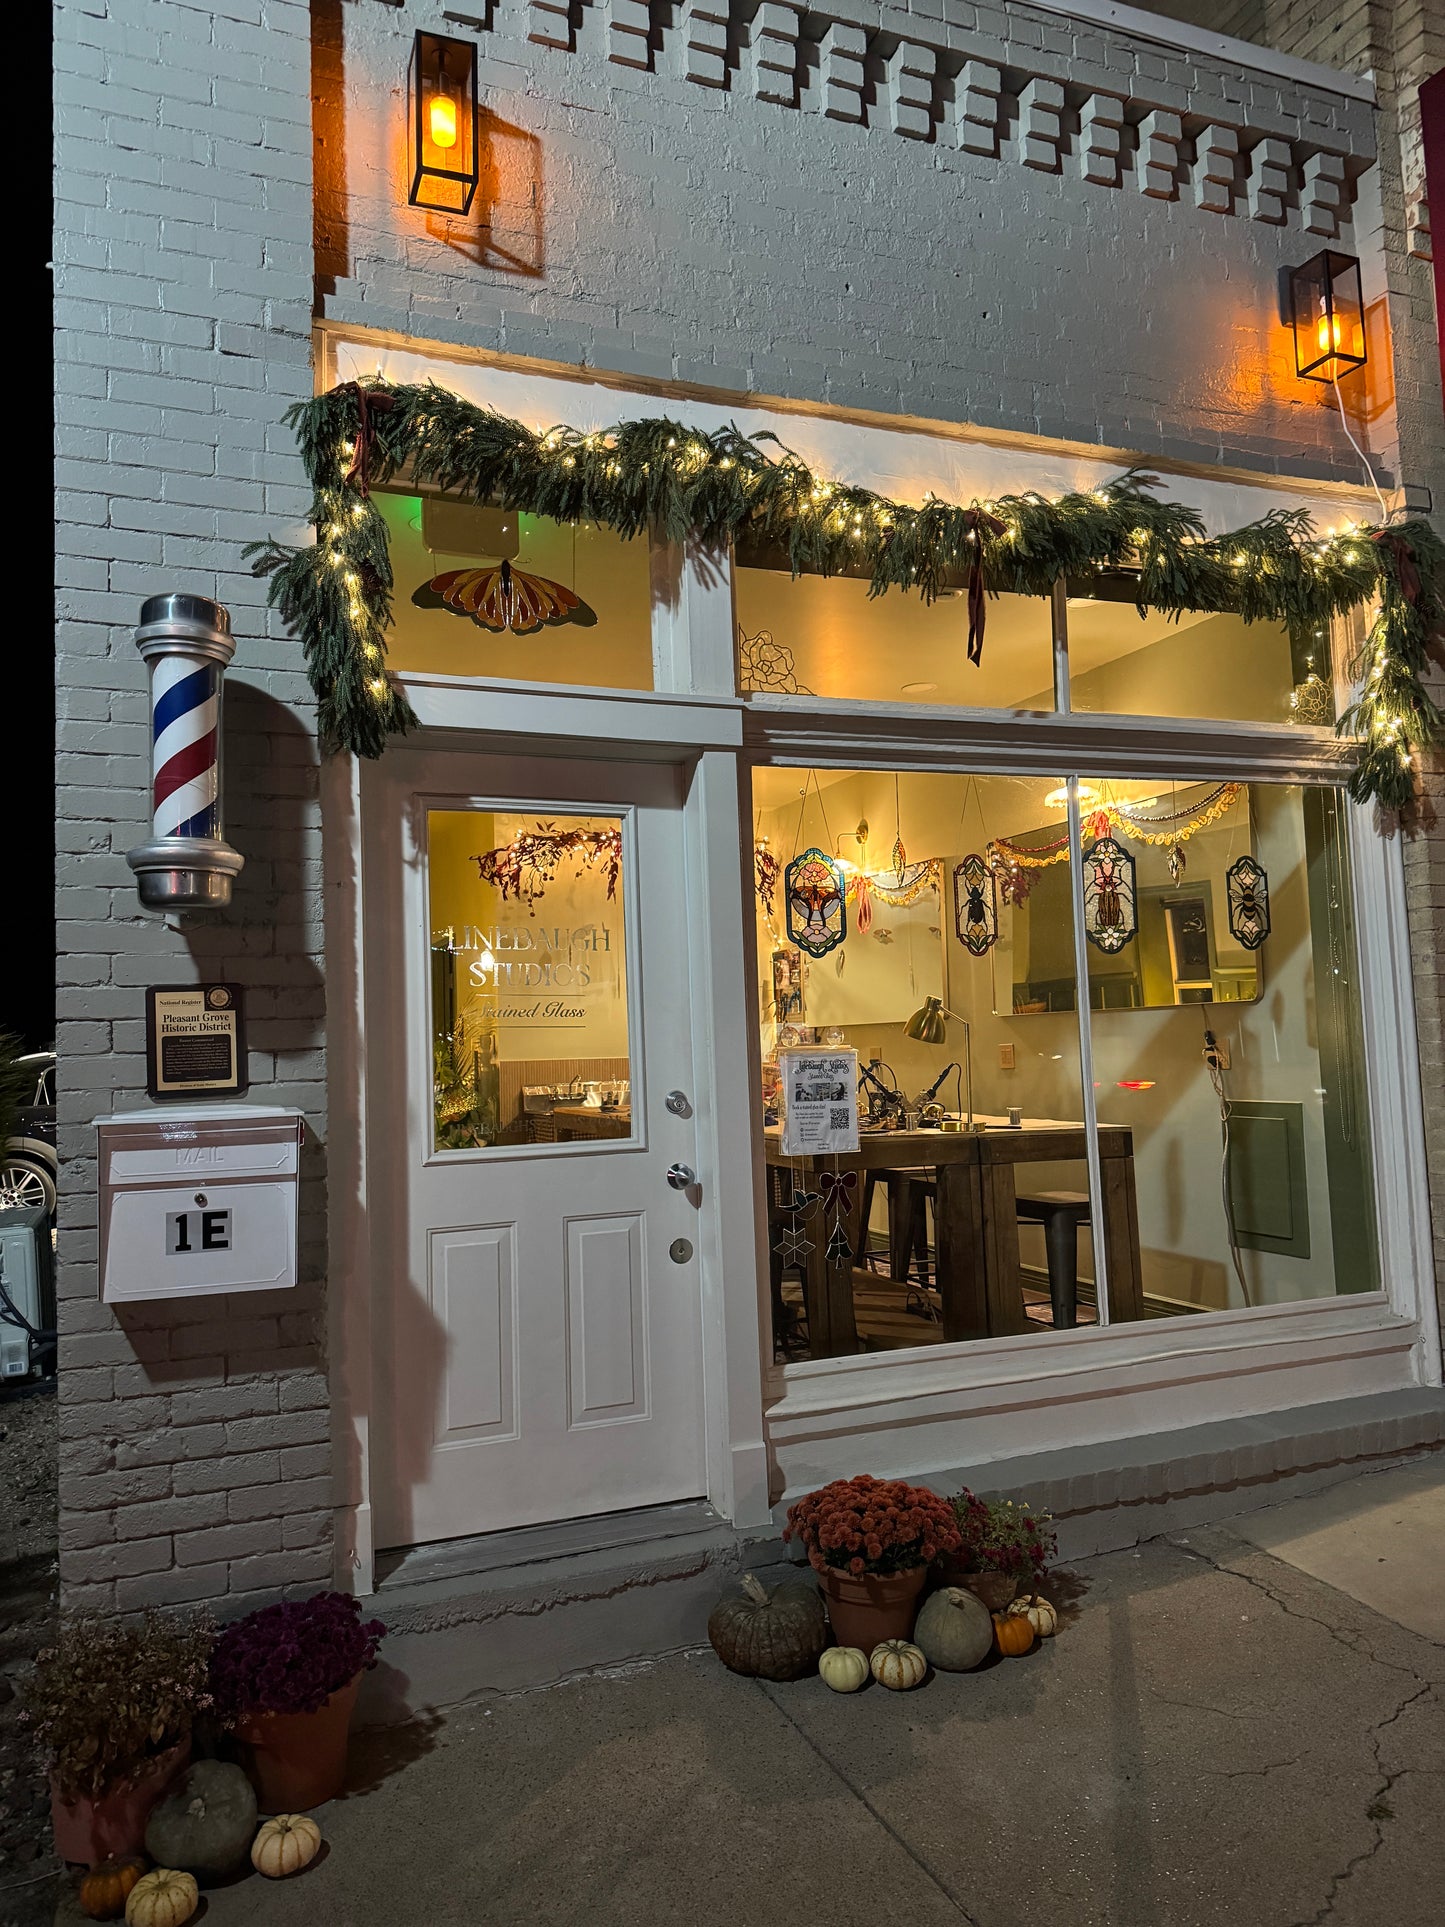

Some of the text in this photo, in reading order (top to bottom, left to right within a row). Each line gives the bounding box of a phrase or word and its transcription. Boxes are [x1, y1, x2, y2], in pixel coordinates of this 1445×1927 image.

[446, 925, 611, 952] LINEBAUGH
[469, 962, 591, 987] STUDIOS
[163, 1012, 230, 1023] Pleasant Grove
[542, 1001, 587, 1018] Glass
[161, 1022, 231, 1033] Historic District
[175, 1147, 224, 1165] MAIL
[175, 1211, 229, 1252] 1E
